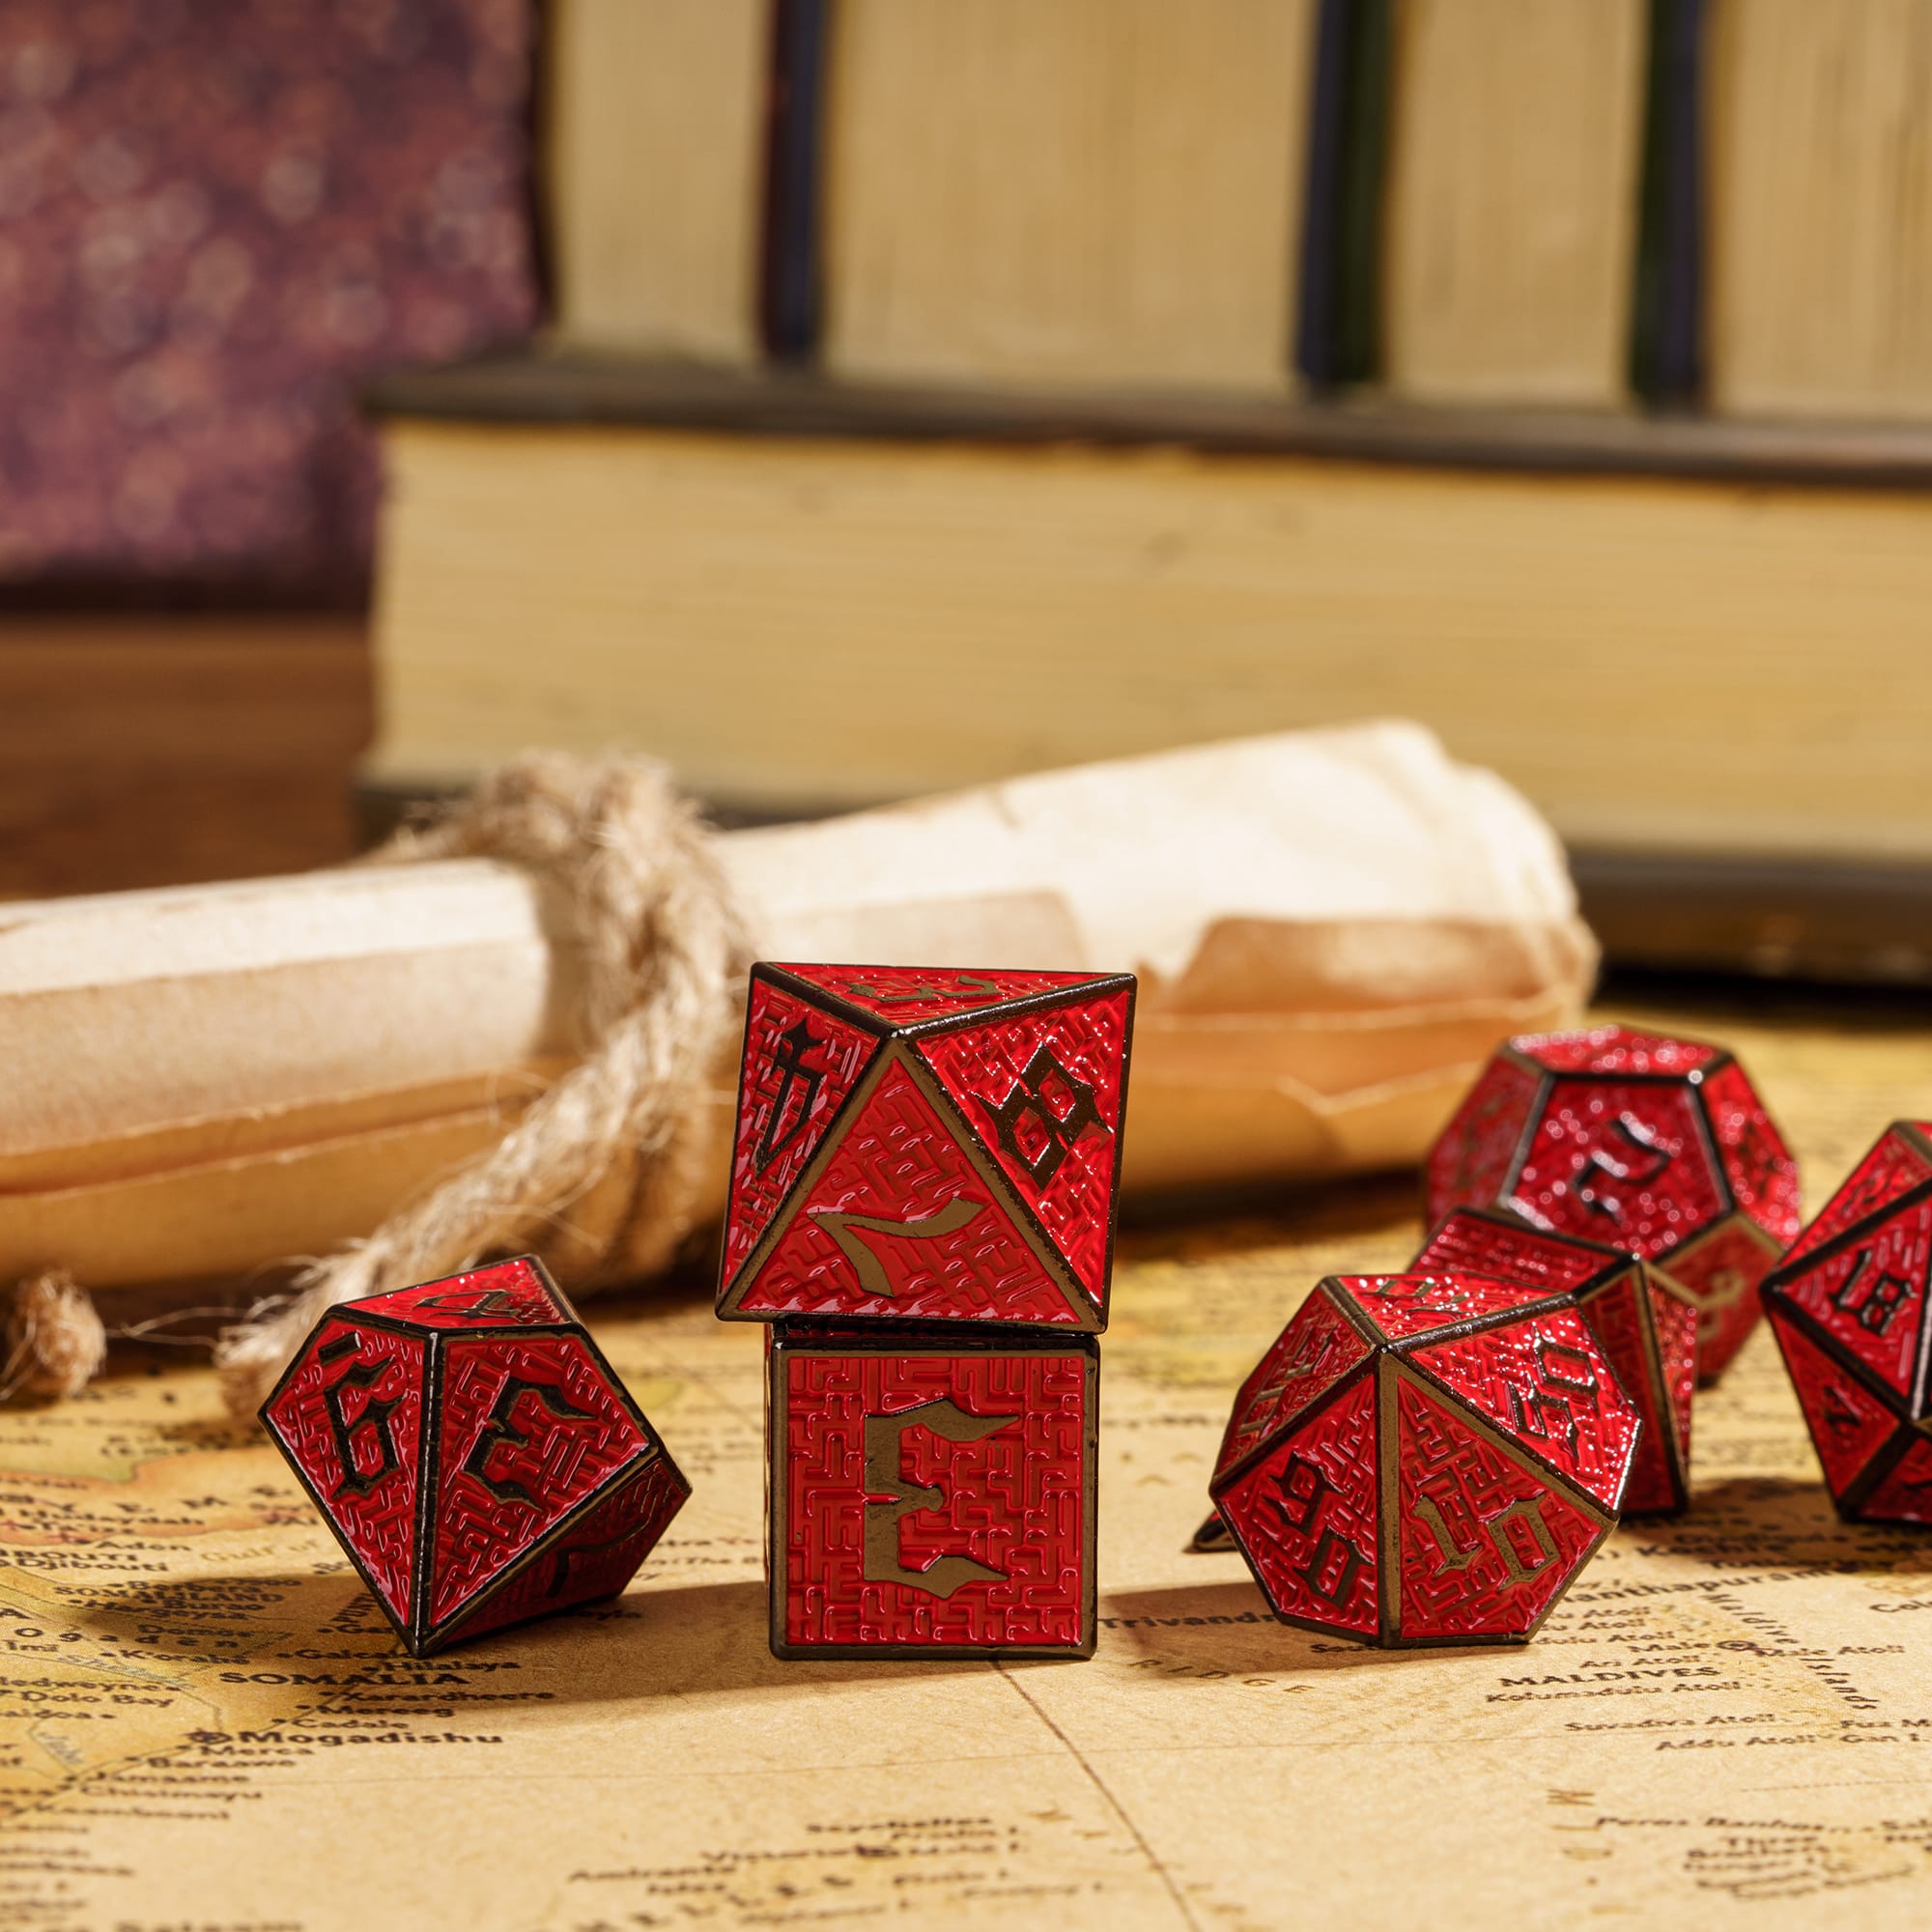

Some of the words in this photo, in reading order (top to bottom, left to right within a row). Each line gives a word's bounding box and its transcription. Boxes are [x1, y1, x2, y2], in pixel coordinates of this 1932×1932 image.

[218, 1672, 472, 1687] SOMALIA
[1498, 1666, 1721, 1688] MALDIVES
[238, 1731, 504, 1747] Mogadishu
